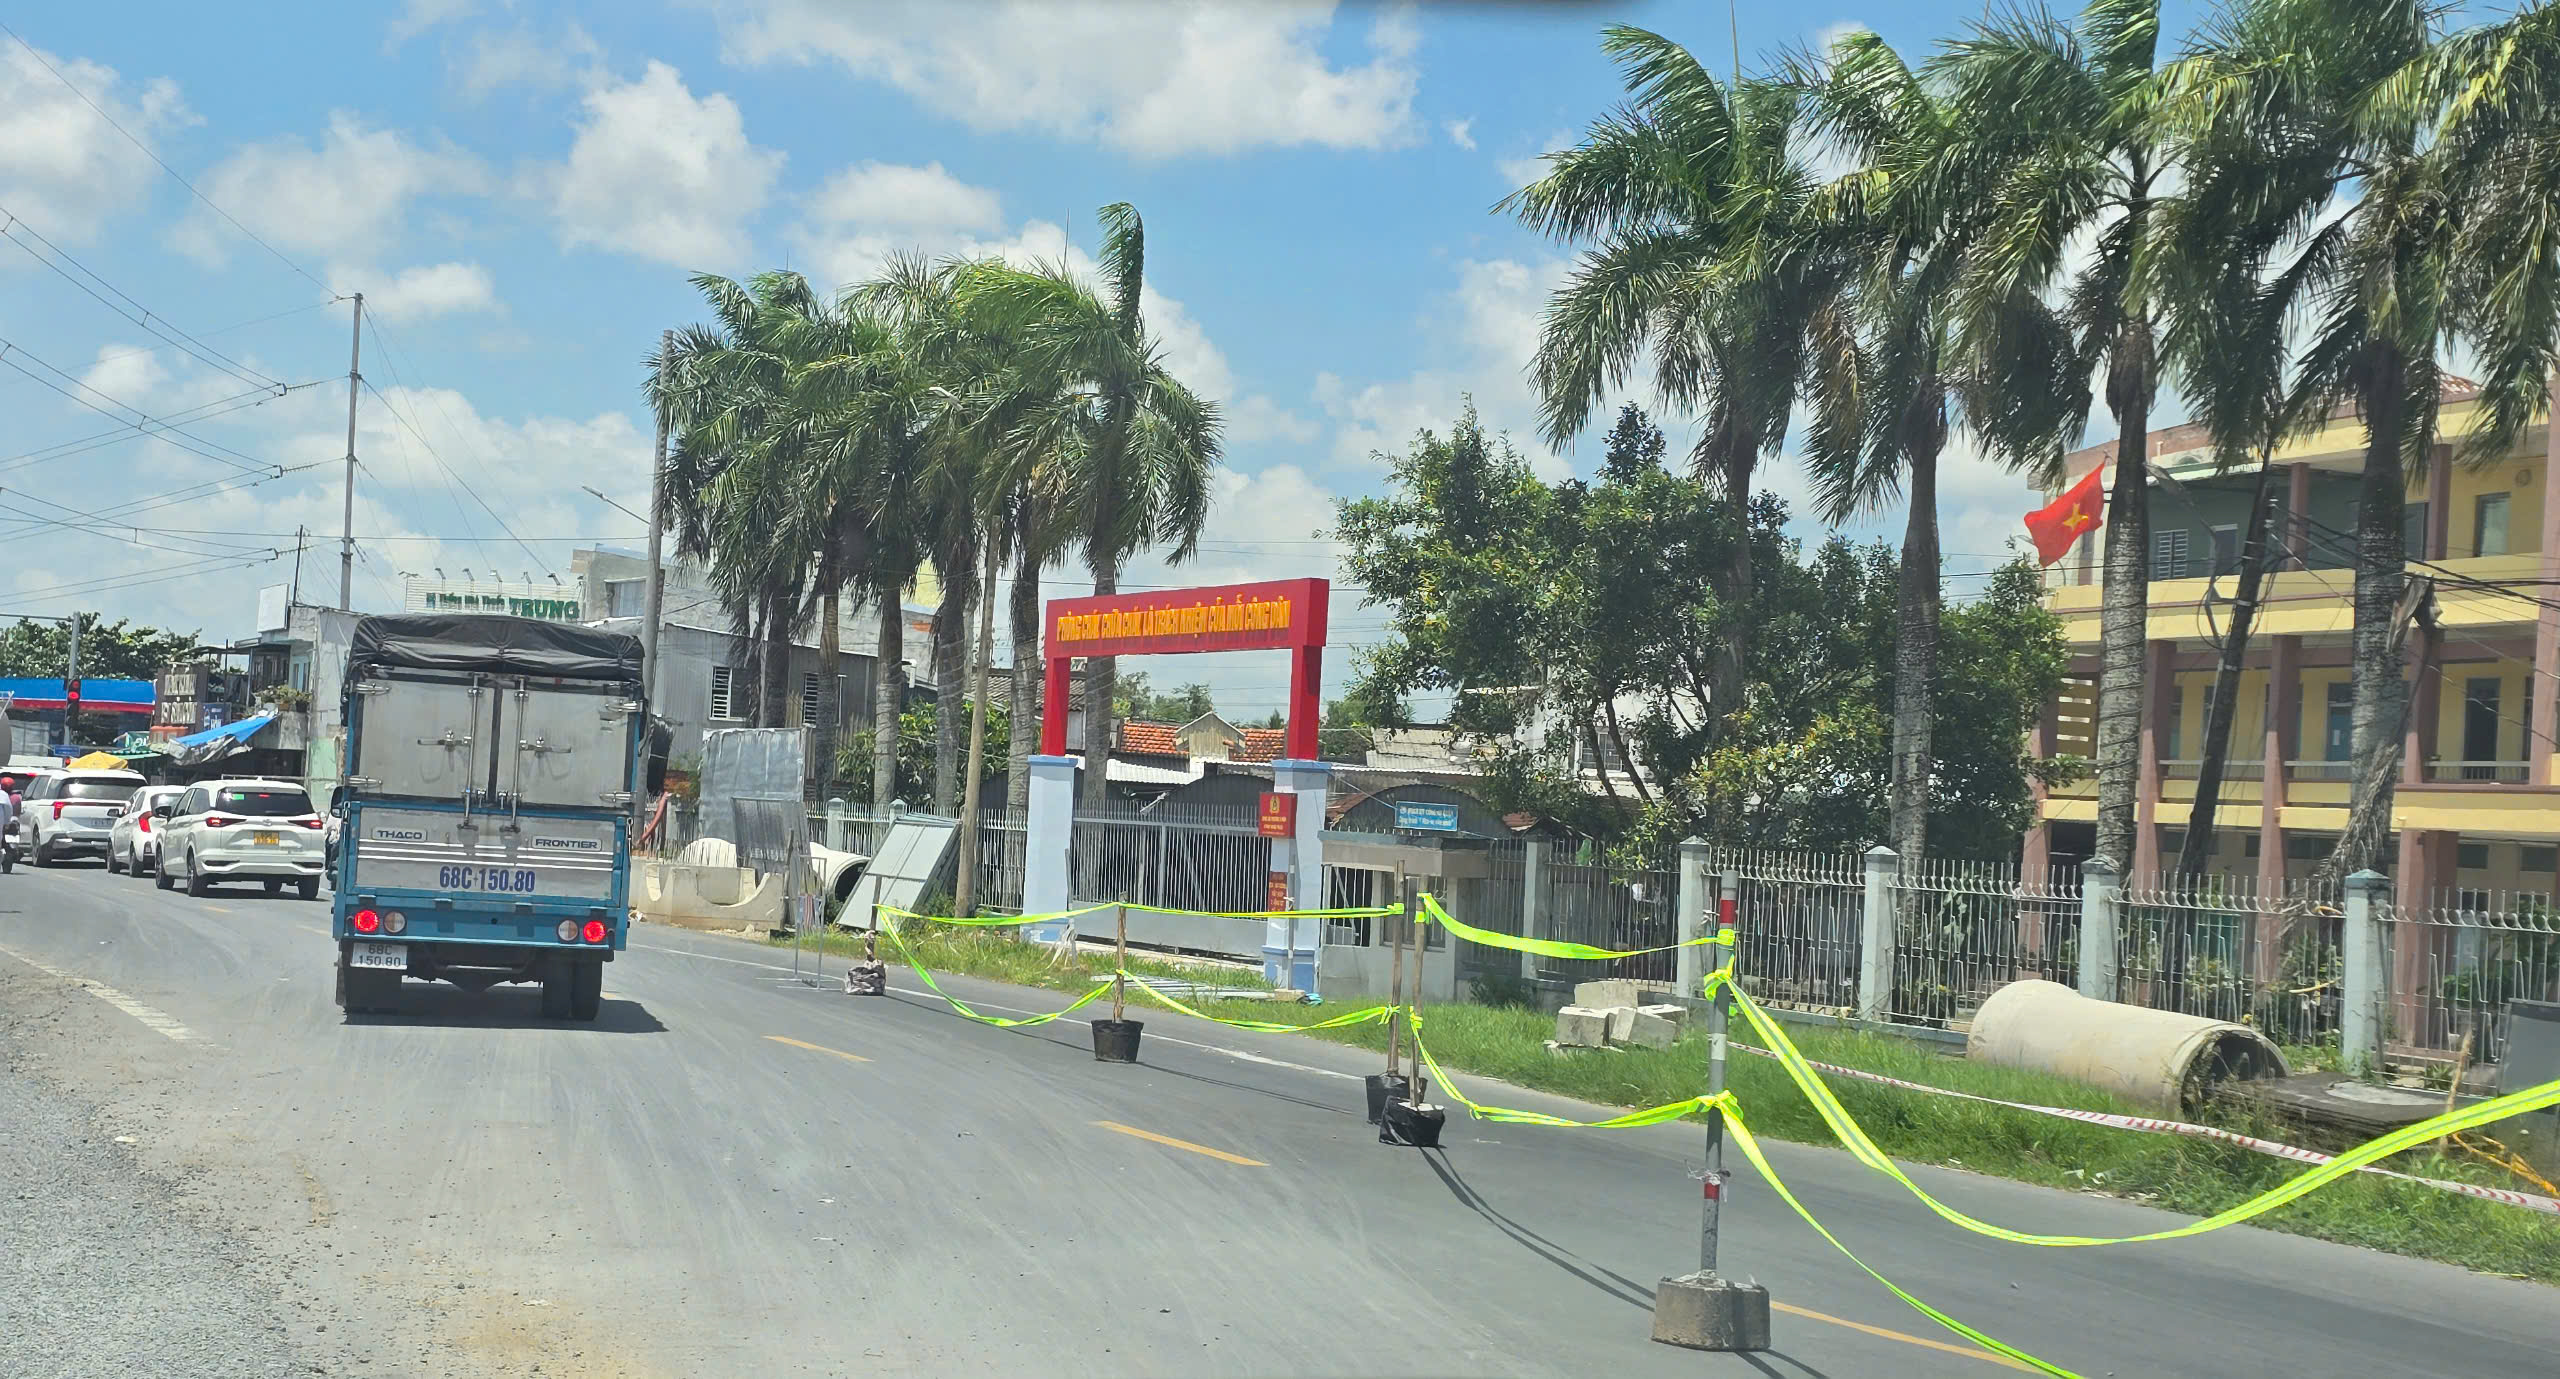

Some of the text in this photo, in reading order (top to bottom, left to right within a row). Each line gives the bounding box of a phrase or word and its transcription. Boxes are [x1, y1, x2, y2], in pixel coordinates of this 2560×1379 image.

[509, 597, 580, 619] TRUNG
[1057, 611, 1082, 642] PHÒNG
[1143, 604, 1154, 636] LÀ
[1154, 603, 1180, 635] TRÁCH
[1180, 602, 1208, 638] NHIỆM
[1208, 597, 1225, 632] CỦA
[1226, 593, 1244, 631] MỖI
[1245, 597, 1270, 631] CÔNG
[1270, 595, 1291, 629] DÂN
[377, 829, 423, 840] THACO
[535, 838, 598, 849] FRONTIER
[368, 944, 392, 955] 68C
[359, 954, 401, 967] 150.80
